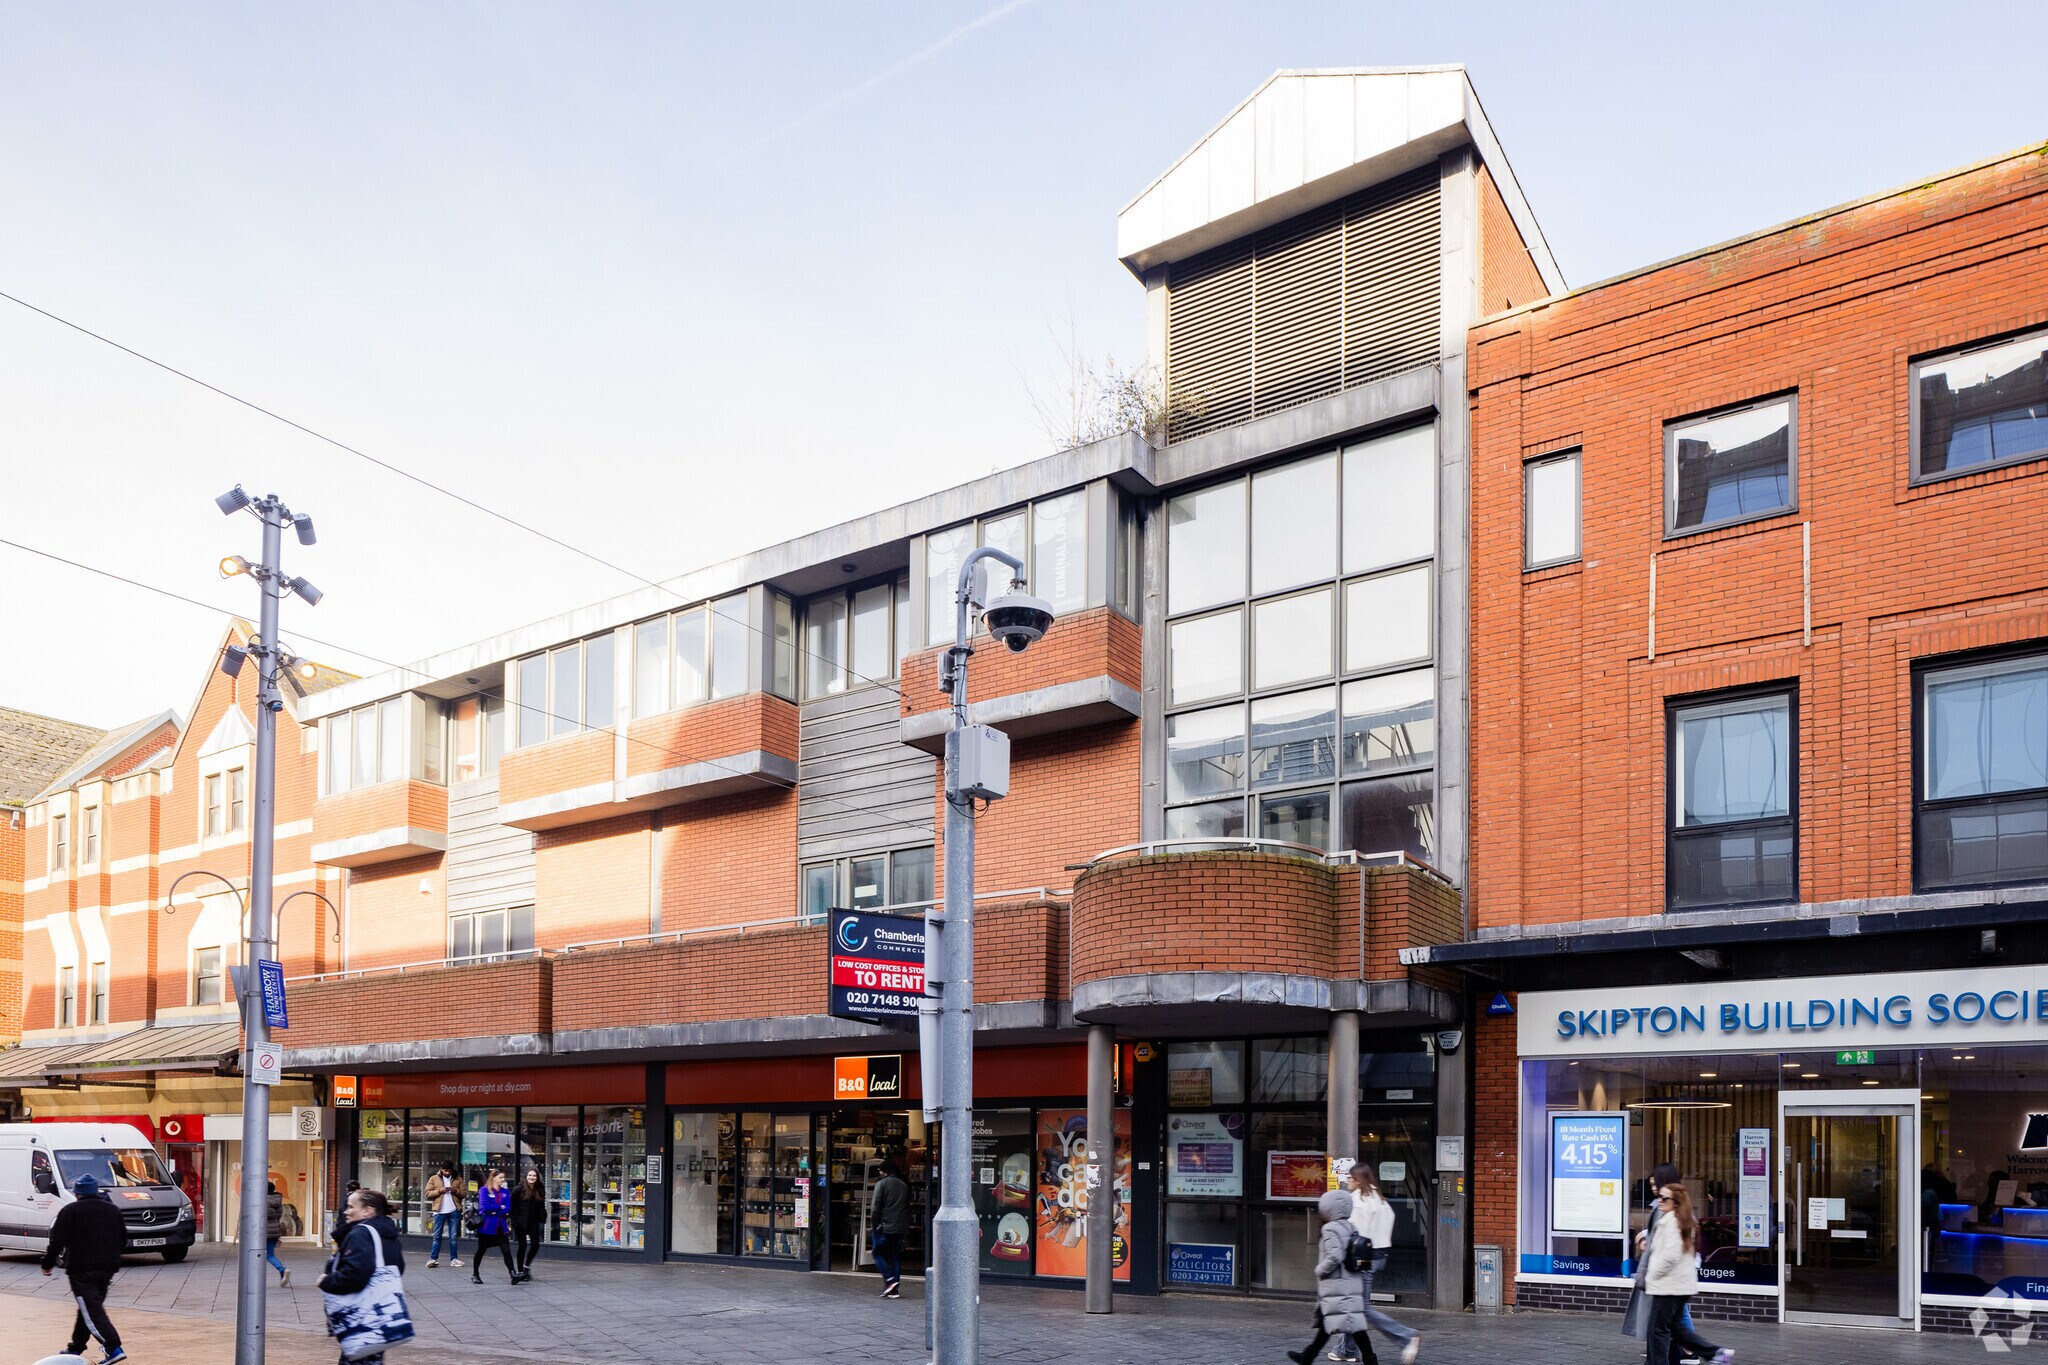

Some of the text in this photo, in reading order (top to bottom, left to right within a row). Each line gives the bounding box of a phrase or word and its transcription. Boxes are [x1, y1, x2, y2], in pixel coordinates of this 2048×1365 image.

[1055, 542, 1066, 598] CRIMINAL
[838, 960, 854, 968] LOW
[854, 962, 872, 970] COST
[873, 963, 901, 972] OFFICES
[854, 970, 922, 990] TO RENT
[262, 969, 275, 1012] HARROW
[846, 992, 869, 1004] 020
[872, 994, 900, 1006] 7148
[1556, 1004, 1705, 1038] SKIPTON
[1720, 995, 1912, 1032] BUILDING
[440, 1084, 457, 1095] Shop
[458, 1084, 469, 1095] day
[479, 1083, 496, 1094] night
[504, 1082, 531, 1094] diy.com
[838, 1077, 864, 1092] B&Q
[300, 1110, 317, 1132] 3
[1056, 1132, 1088, 1157] Yo
[1172, 1260, 1231, 1271] SOLICITORS
[1552, 1259, 1590, 1271] Savings
